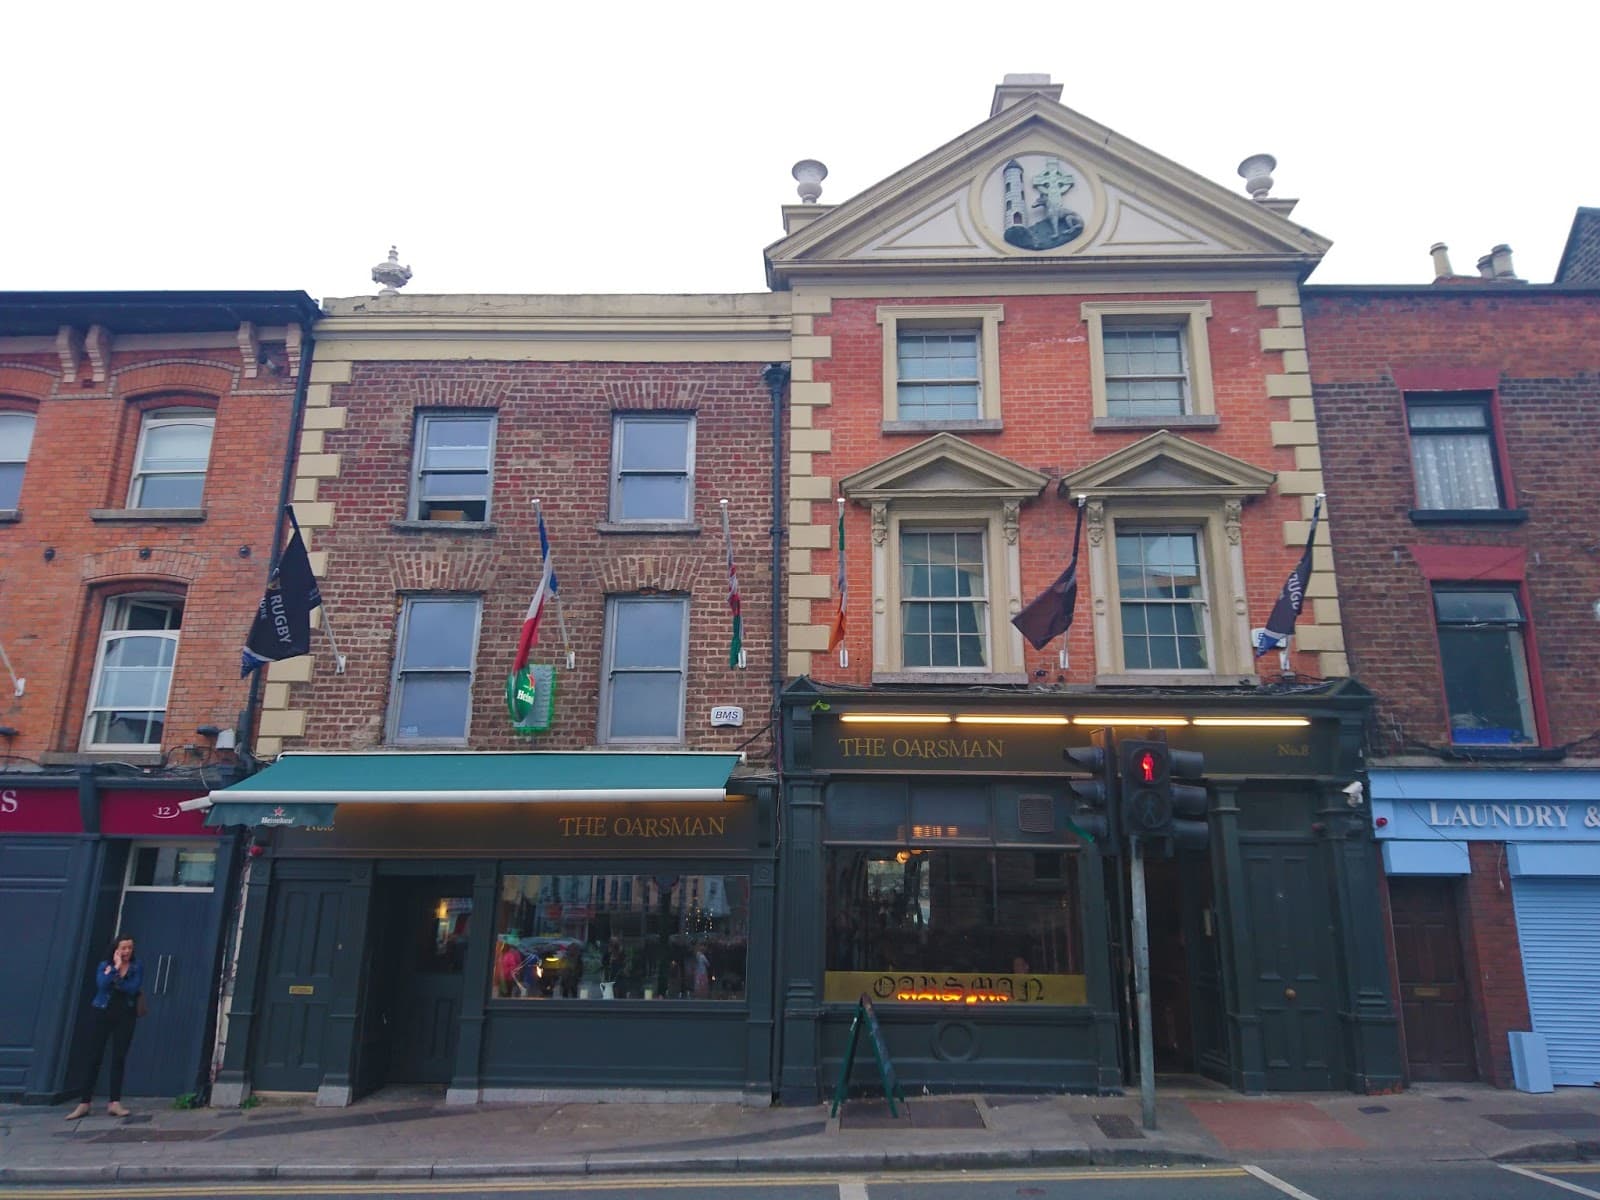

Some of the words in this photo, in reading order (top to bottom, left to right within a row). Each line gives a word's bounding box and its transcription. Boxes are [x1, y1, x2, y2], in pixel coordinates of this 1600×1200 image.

[270, 594, 292, 643] RUGBY
[715, 711, 738, 719] BMS
[838, 737, 887, 757] THE
[892, 737, 1005, 758] OARSMAN
[0, 790, 18, 812] S
[157, 806, 171, 816] 12
[1429, 801, 1569, 827] LAUNDRY
[559, 816, 607, 837] THE
[614, 816, 727, 837] OARSMAN
